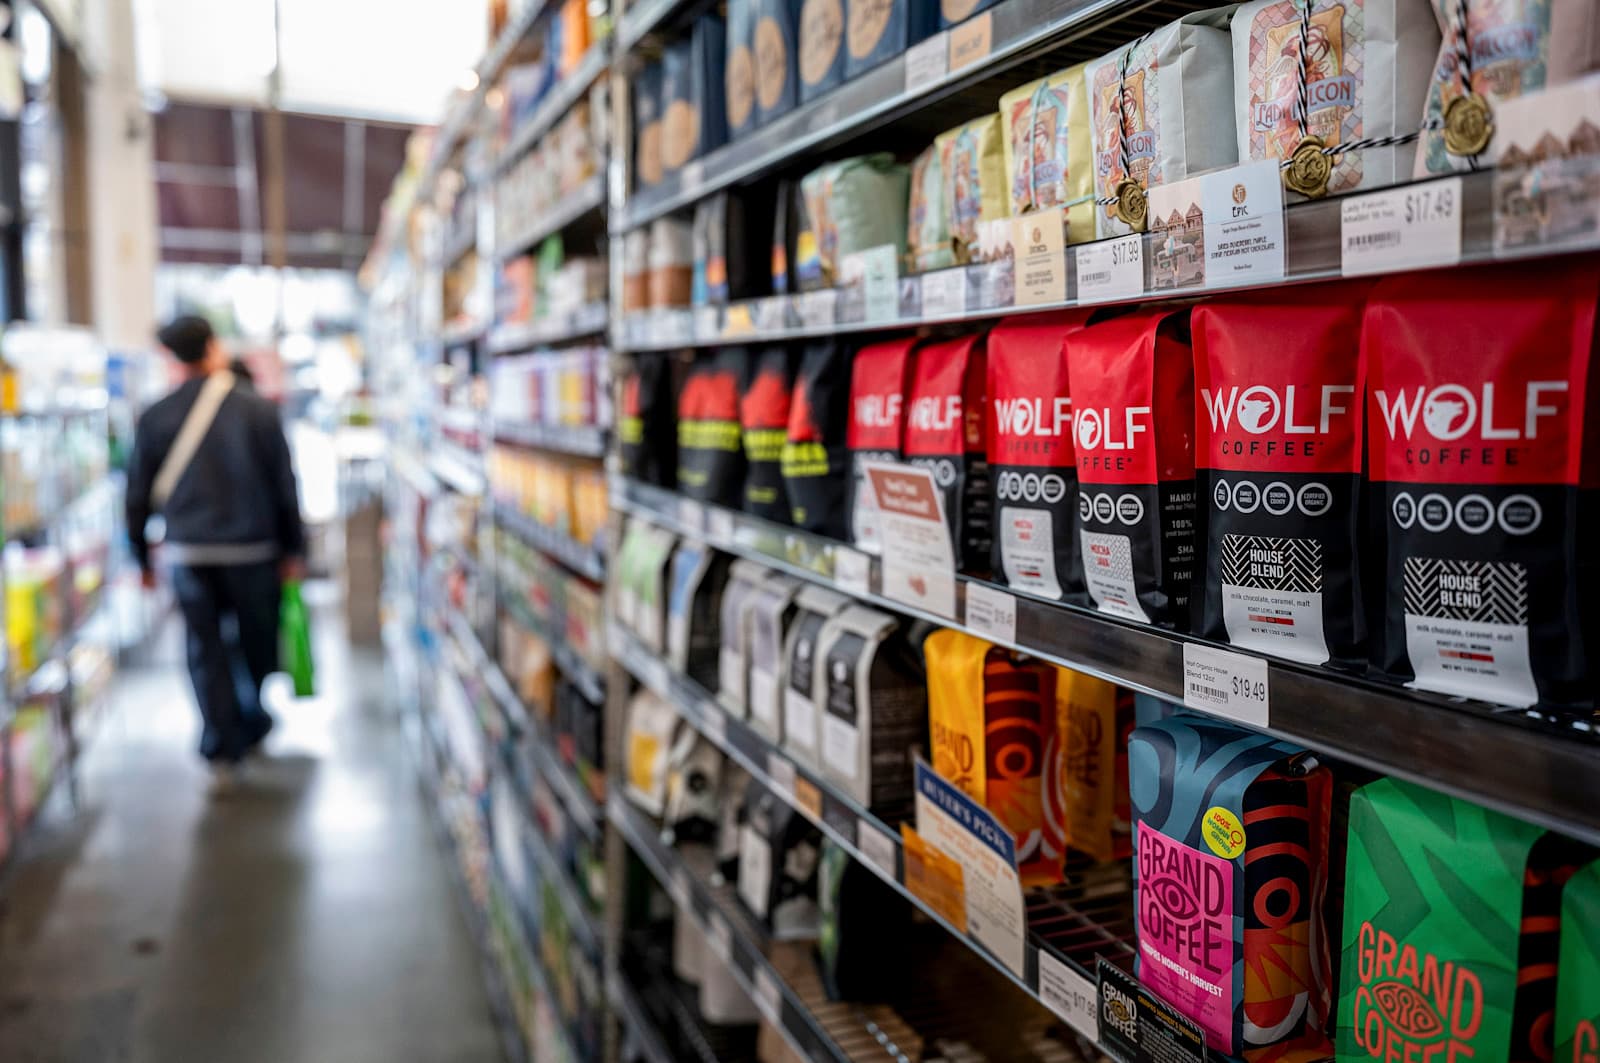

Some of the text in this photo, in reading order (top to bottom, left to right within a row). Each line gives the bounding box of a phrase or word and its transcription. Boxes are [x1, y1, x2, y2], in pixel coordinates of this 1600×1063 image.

[1232, 205, 1249, 218] EPIC
[1112, 240, 1140, 264] $17.99
[995, 398, 1072, 436] WOLF
[1201, 384, 1355, 435] WOLF
[1374, 380, 1569, 441] WOLF
[1222, 441, 1315, 457] COFFEE
[1406, 448, 1519, 465] COFFEE
[1170, 494, 1191, 502] HAND
[1172, 520, 1192, 529] 100%
[1250, 549, 1284, 564] HOUSE
[1251, 563, 1284, 578] BLEND
[1439, 574, 1481, 592] HOUSE
[1231, 593, 1242, 601] milk
[1243, 594, 1269, 604] chocolate,
[1271, 598, 1296, 607] caramel,
[1440, 591, 1481, 609] BLEND
[1186, 669, 1215, 682] Blend 12oz
[1233, 675, 1265, 702] $19.49
[1207, 816, 1230, 840] WOMAN
[1213, 812, 1231, 830] 100%
[1210, 830, 1232, 854] GROWN
[1140, 830, 1225, 918] GRAND
[1140, 882, 1222, 976] COFFEE
[1161, 954, 1189, 980] WOMEN'S
[1190, 972, 1224, 998] HARVEST
[1358, 920, 1484, 1041] GRAND
[1103, 981, 1137, 1021] GRAND
[1103, 1001, 1138, 1044] COFFEE
